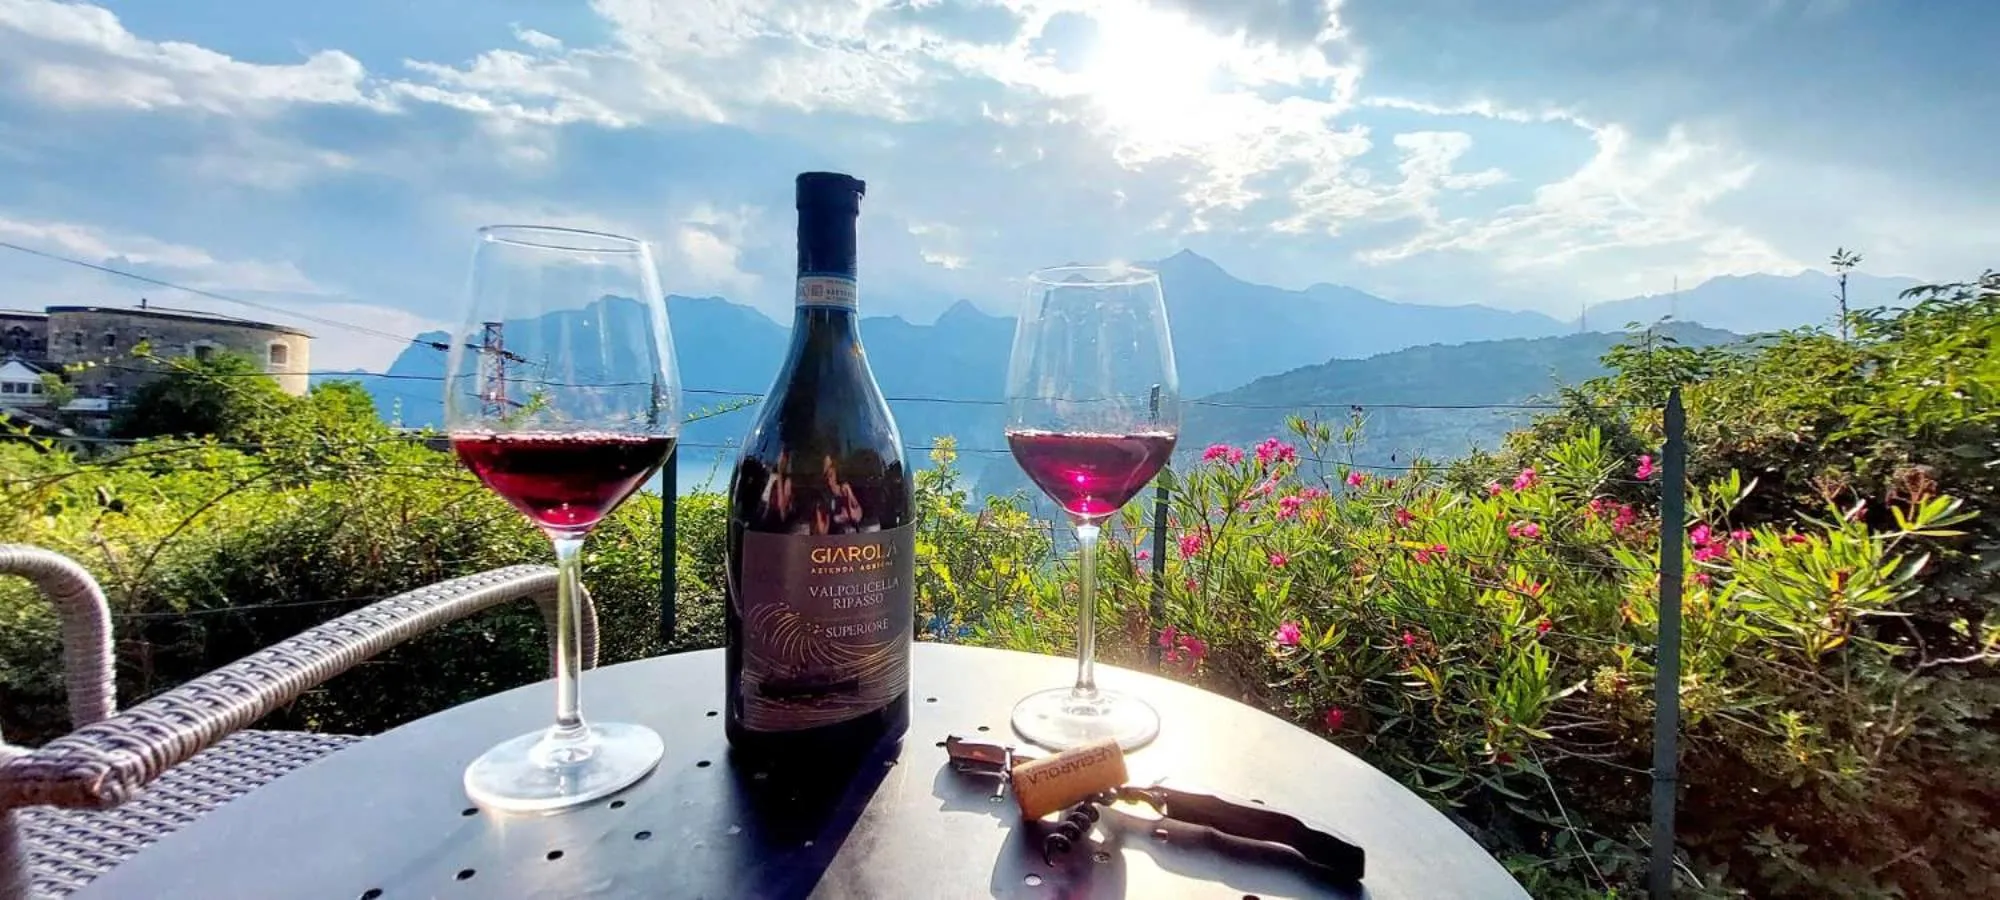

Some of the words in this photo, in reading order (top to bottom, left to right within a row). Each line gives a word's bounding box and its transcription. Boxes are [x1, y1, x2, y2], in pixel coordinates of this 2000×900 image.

[811, 540, 898, 564] GIAROLA
[809, 577, 900, 598] VALPOLICELLA
[832, 592, 884, 610] RIPASSO
[825, 618, 889, 638] SUPERIORE
